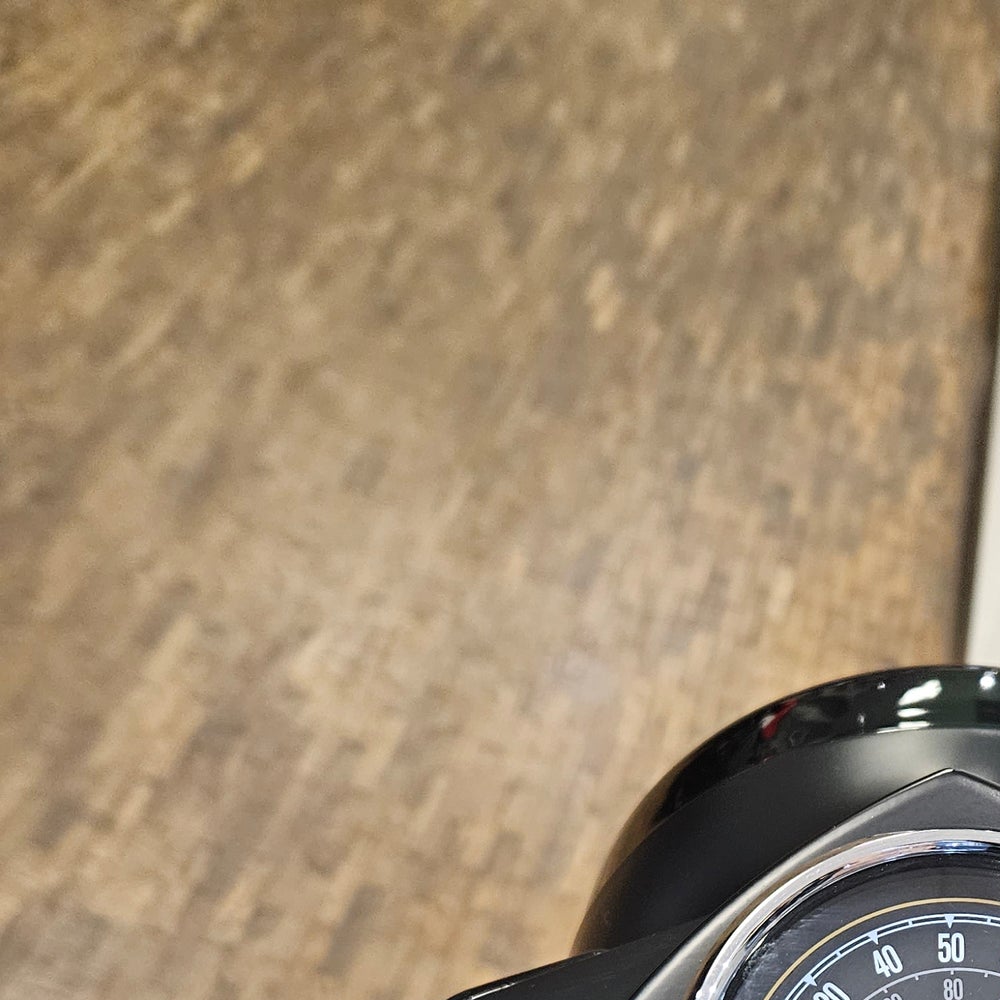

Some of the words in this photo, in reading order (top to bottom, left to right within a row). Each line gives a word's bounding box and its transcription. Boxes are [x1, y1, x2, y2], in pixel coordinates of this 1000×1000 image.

[872, 944, 903, 978] 40
[937, 932, 965, 963] 50
[943, 978, 964, 1000] 80
